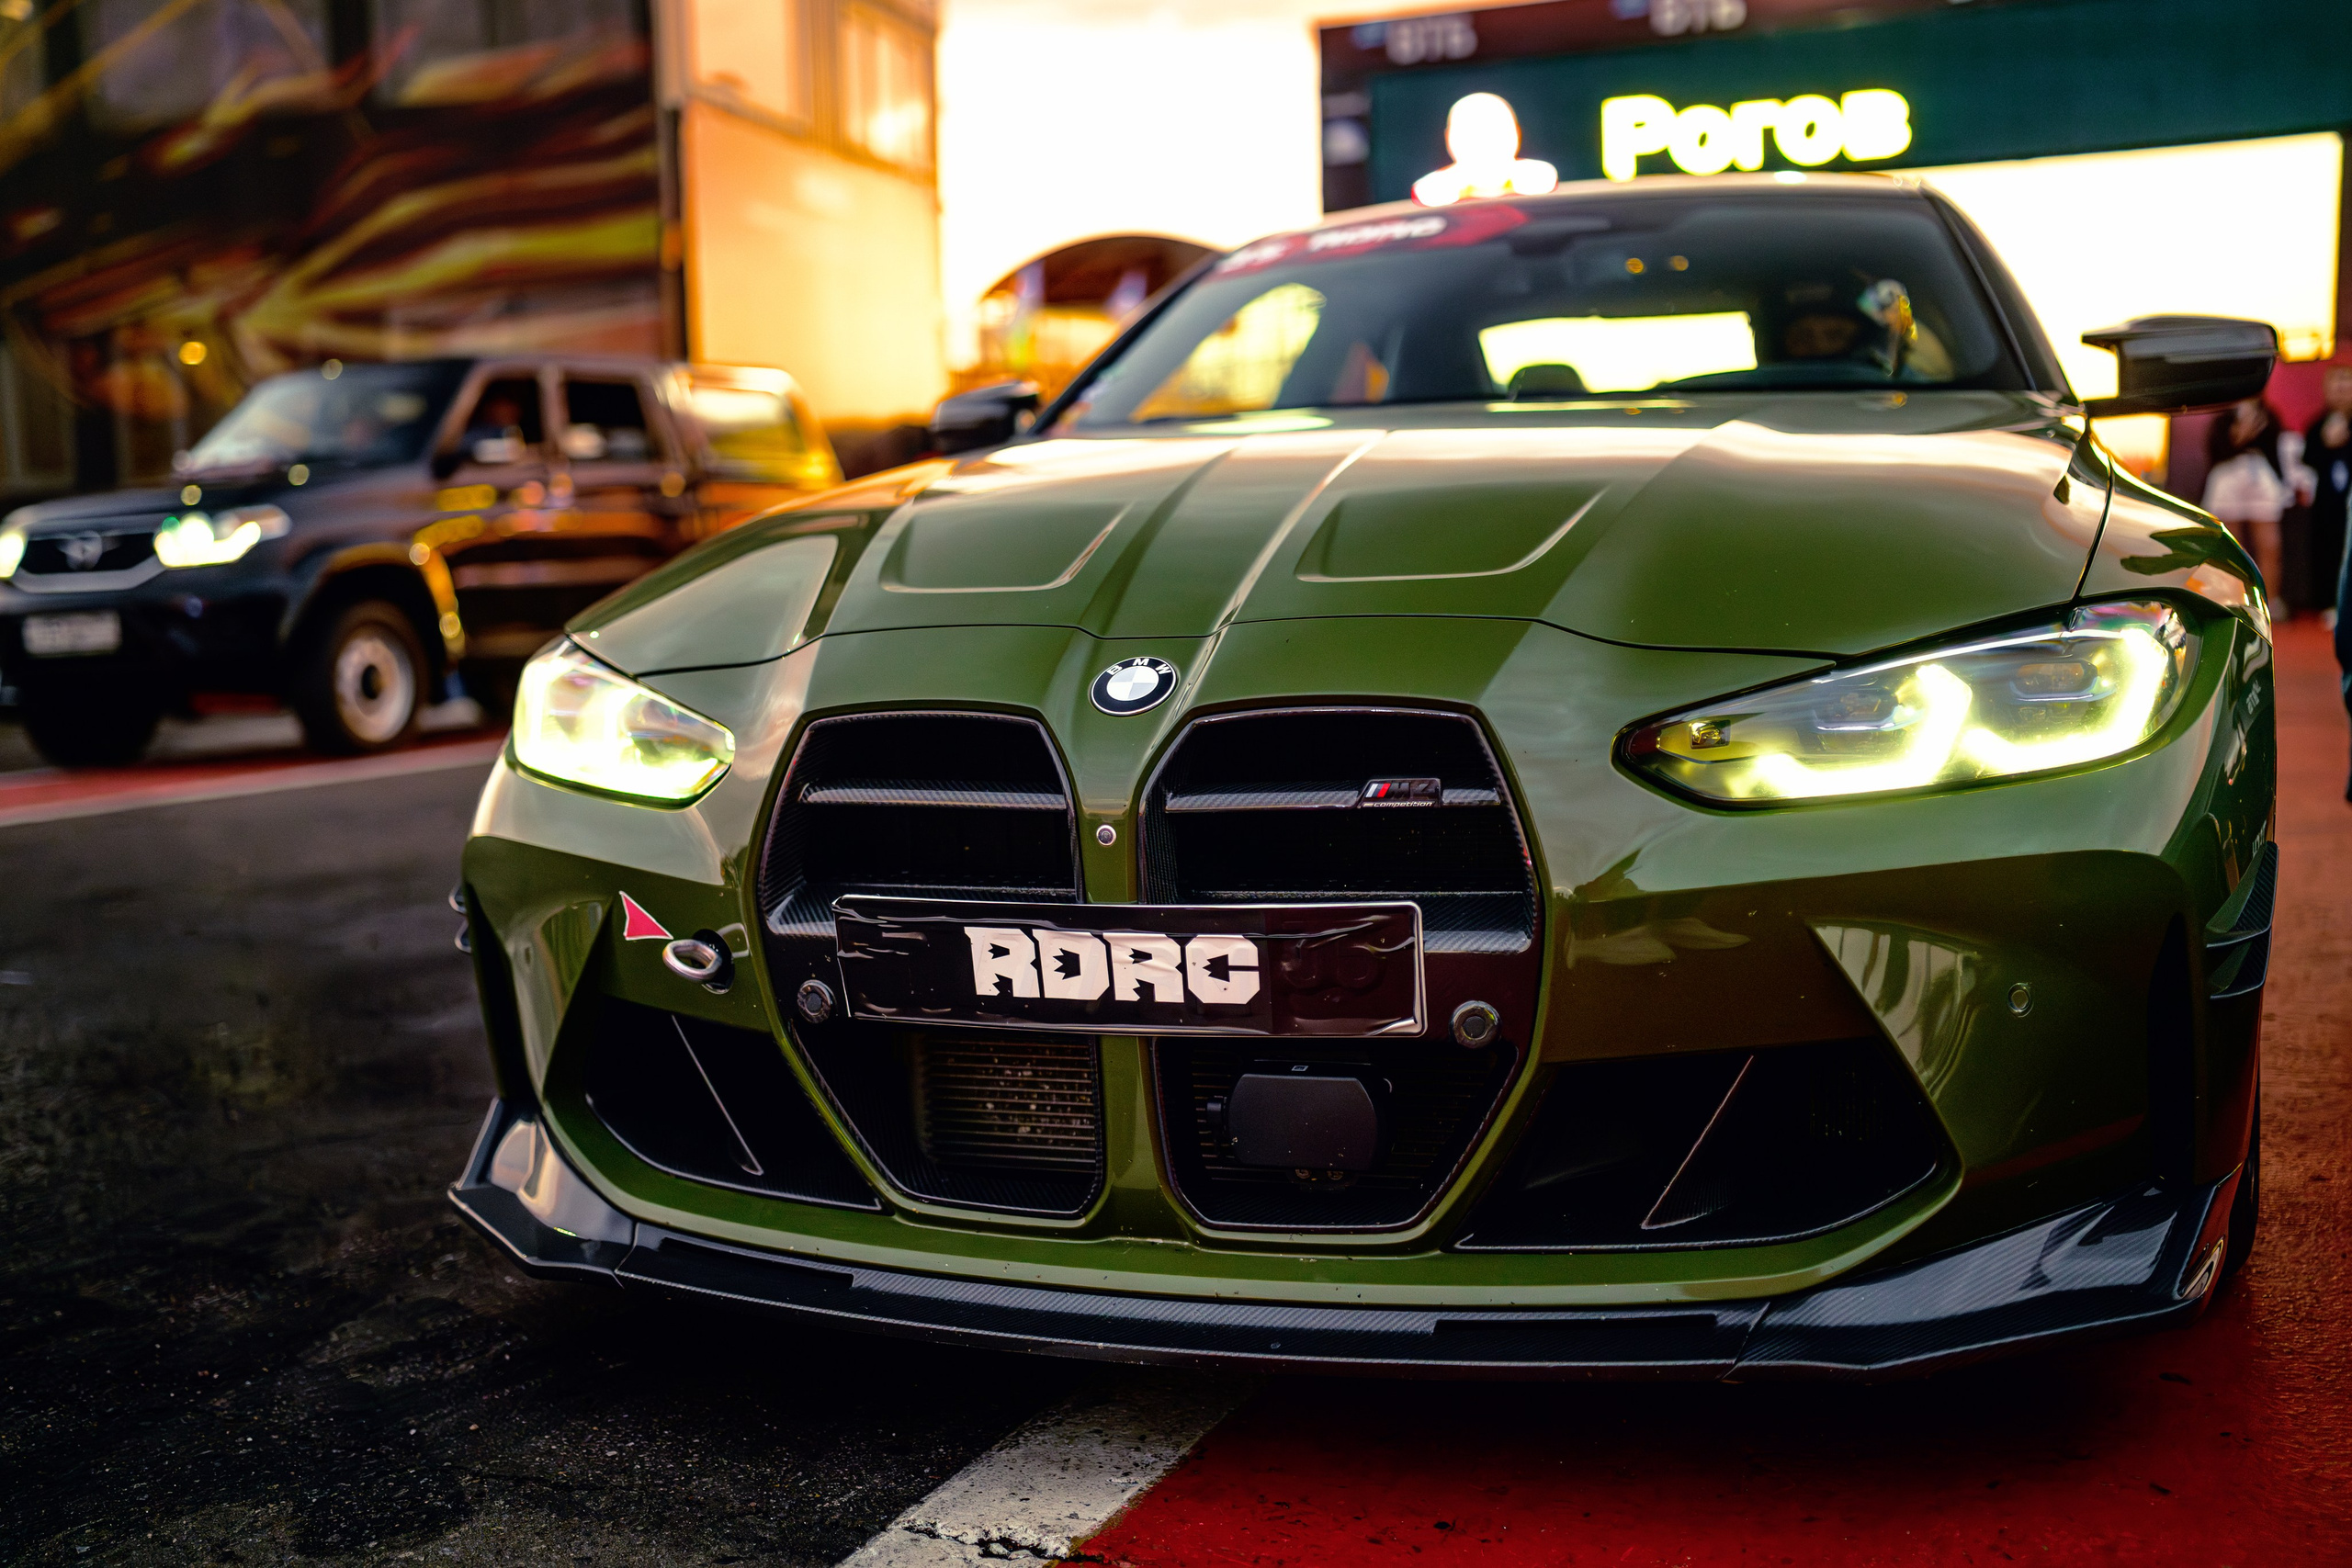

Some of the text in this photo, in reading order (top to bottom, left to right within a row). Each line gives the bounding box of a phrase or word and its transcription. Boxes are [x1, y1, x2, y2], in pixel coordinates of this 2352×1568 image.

[1601, 89, 1912, 183] Рогов
[1106, 658, 1172, 676] BMW
[964, 926, 1261, 1005] RDRC
